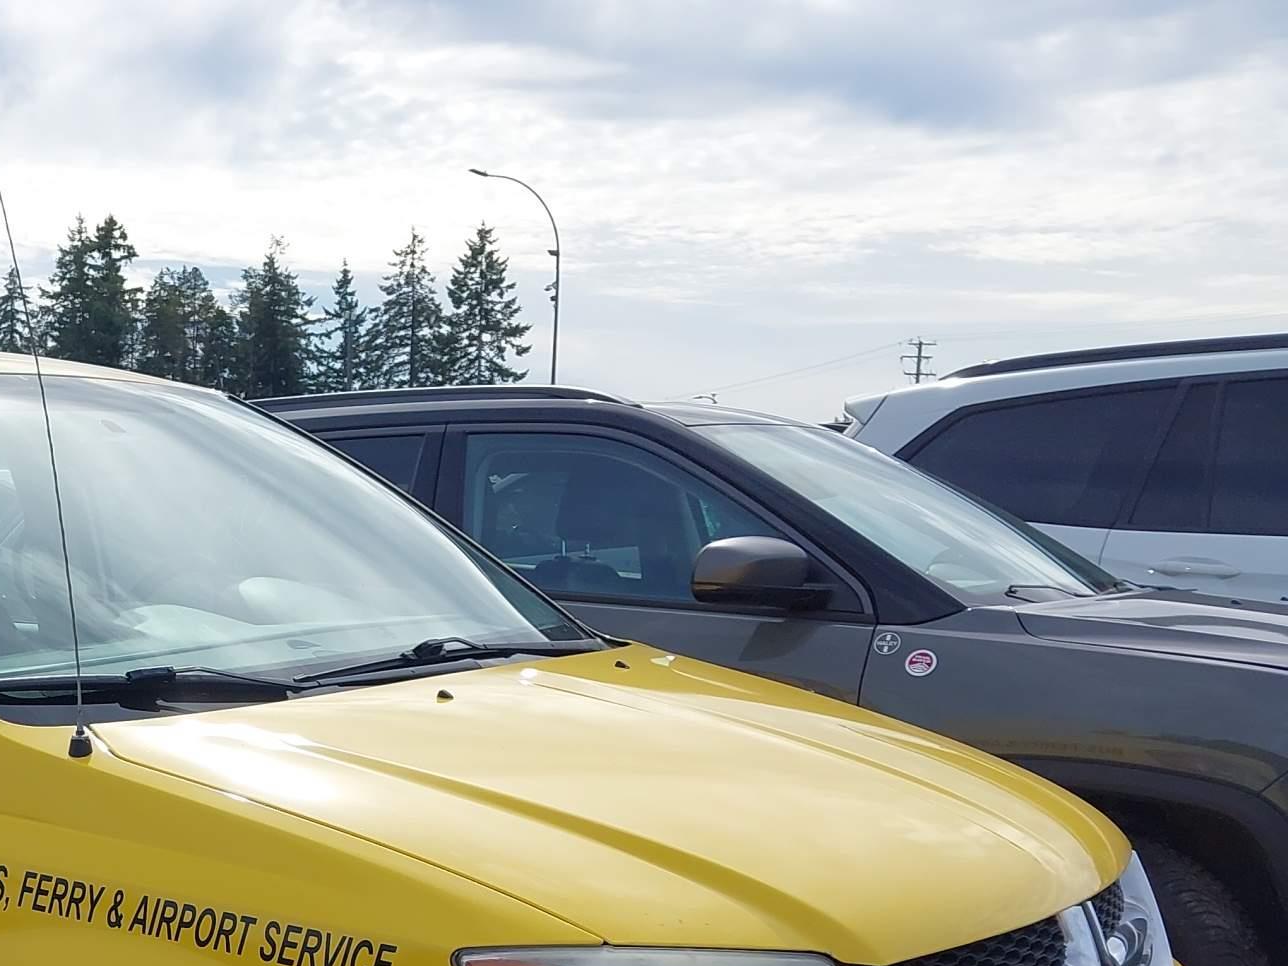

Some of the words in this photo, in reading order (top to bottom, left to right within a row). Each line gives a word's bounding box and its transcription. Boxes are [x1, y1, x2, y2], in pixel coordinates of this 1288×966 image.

[17, 871, 105, 923] FERRY
[106, 889, 124, 929] &
[128, 895, 257, 956] AIRPORT
